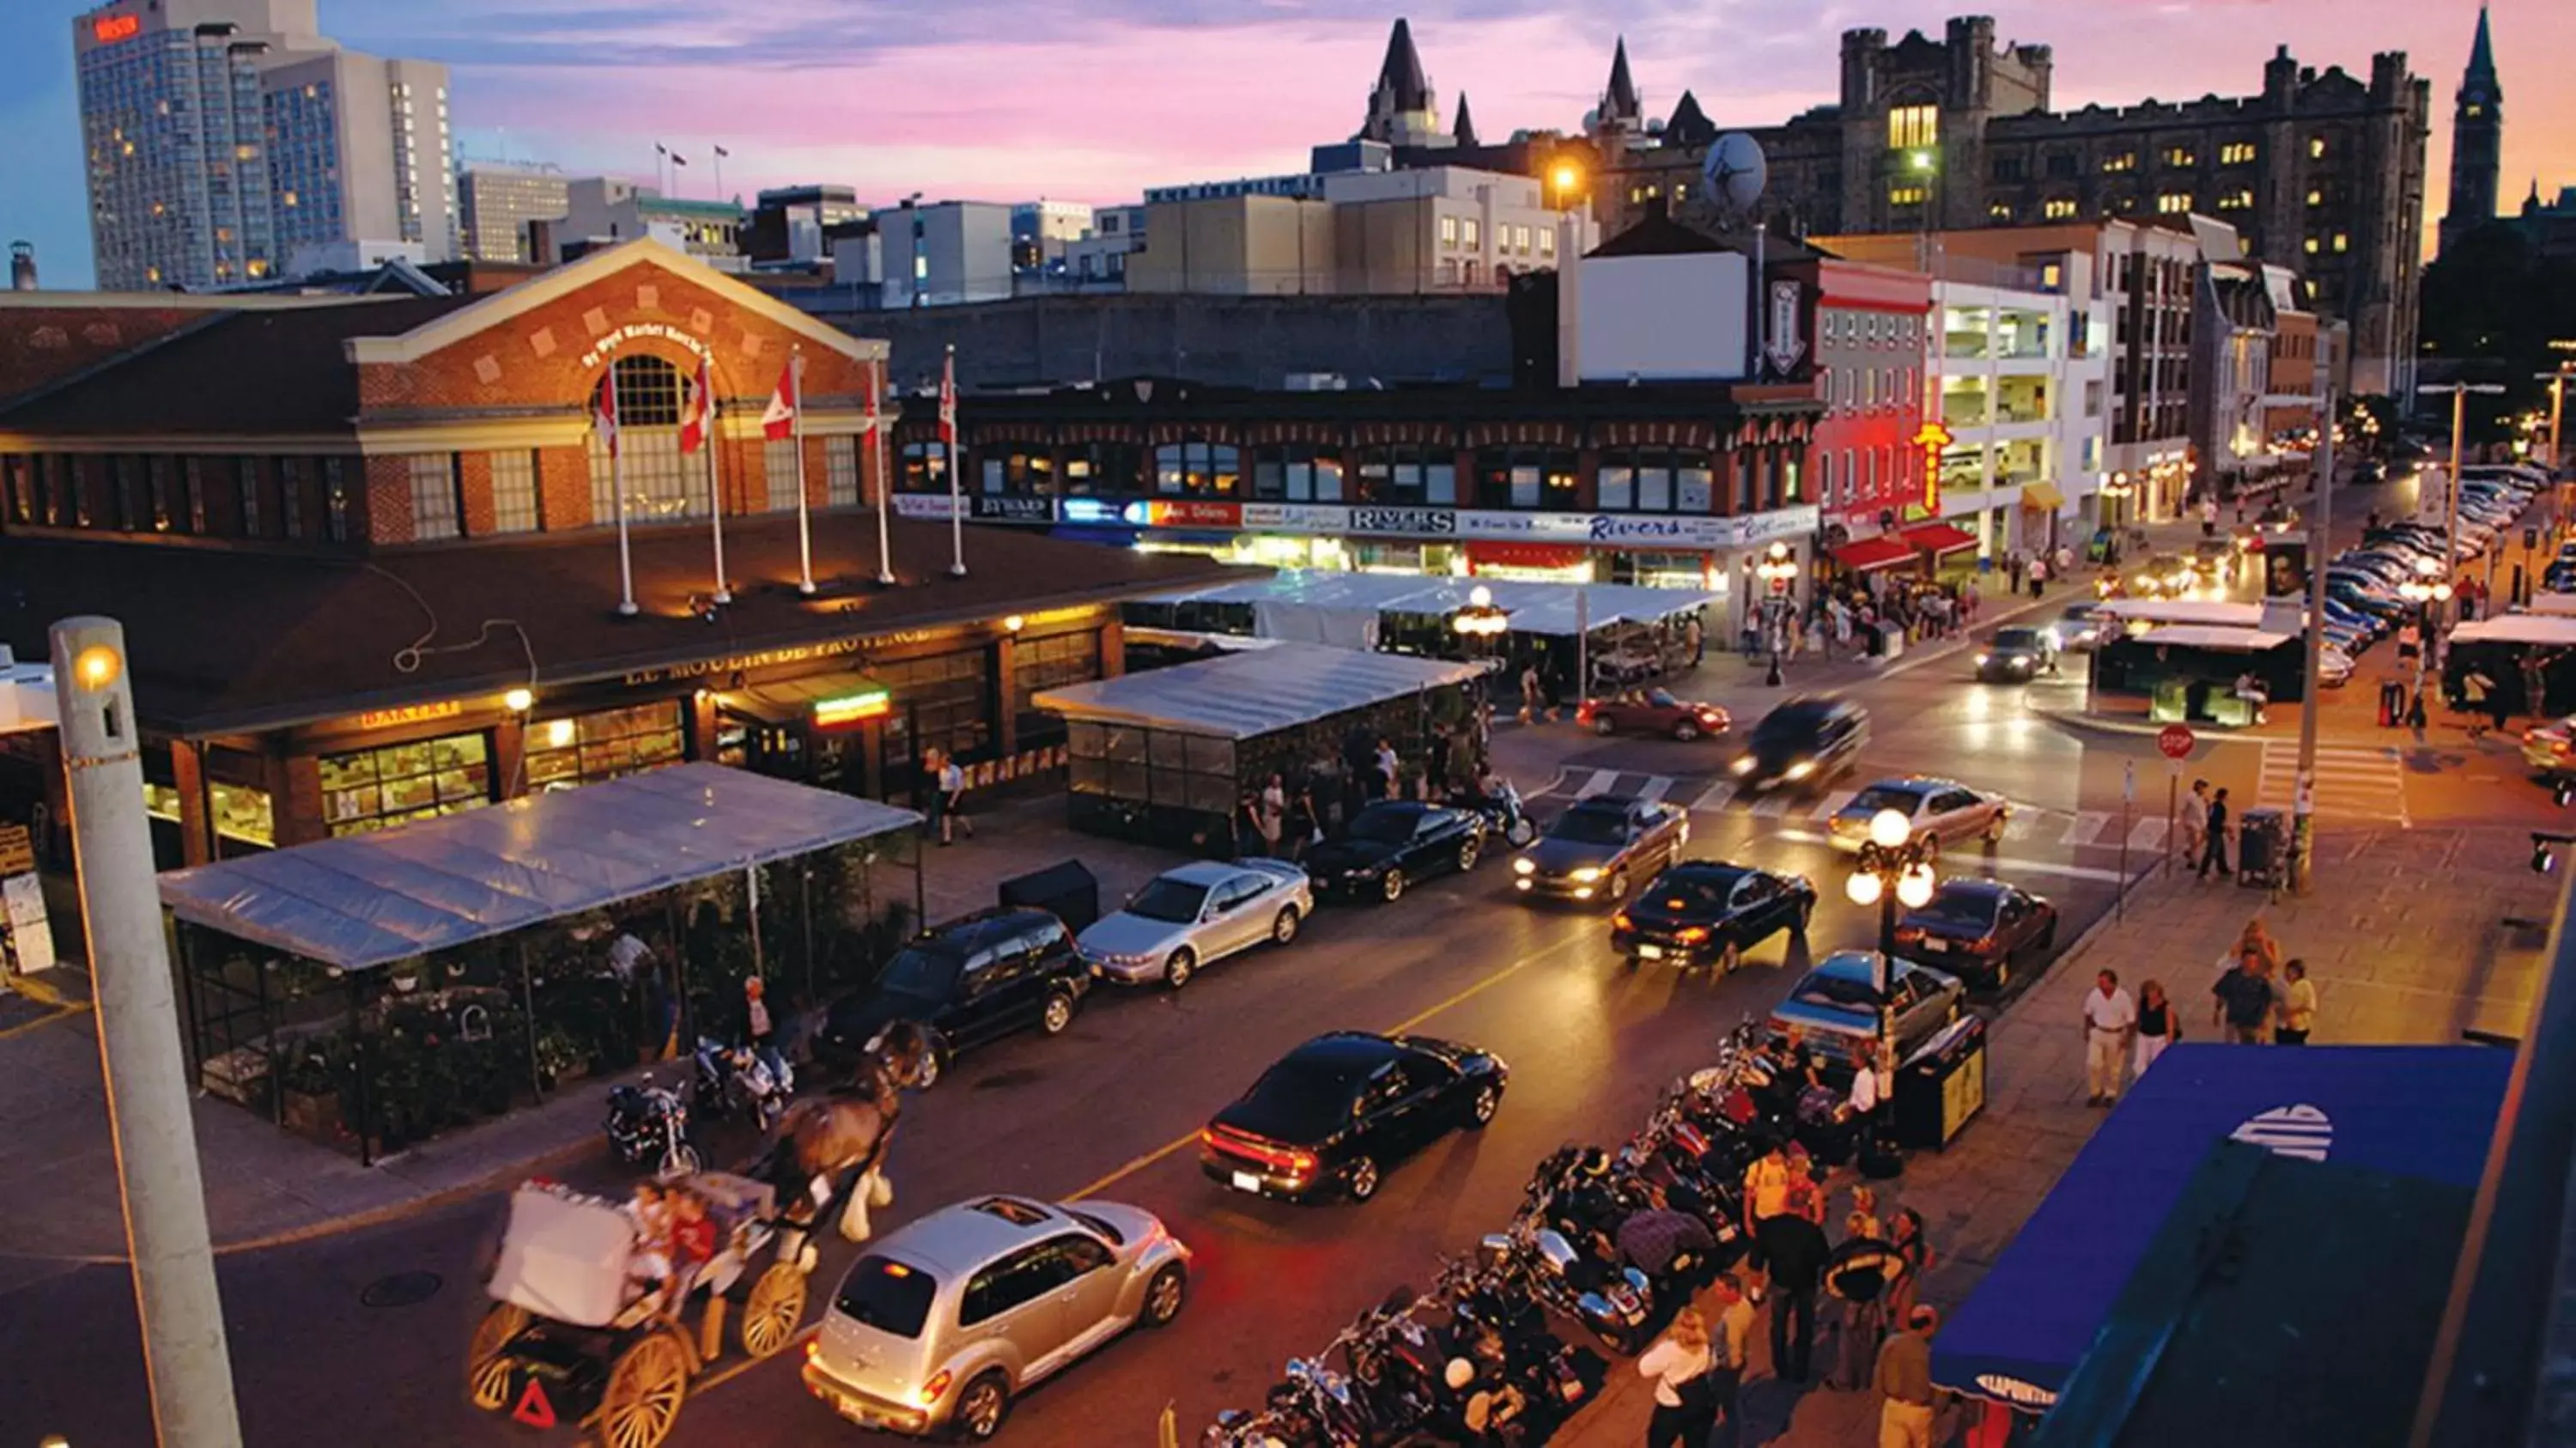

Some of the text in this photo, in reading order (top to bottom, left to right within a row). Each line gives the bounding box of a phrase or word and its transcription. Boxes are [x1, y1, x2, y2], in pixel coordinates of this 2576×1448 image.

[1589, 514, 1680, 540] Rivers
[364, 700, 455, 725] BAKERY
[2161, 734, 2191, 749] STOP
